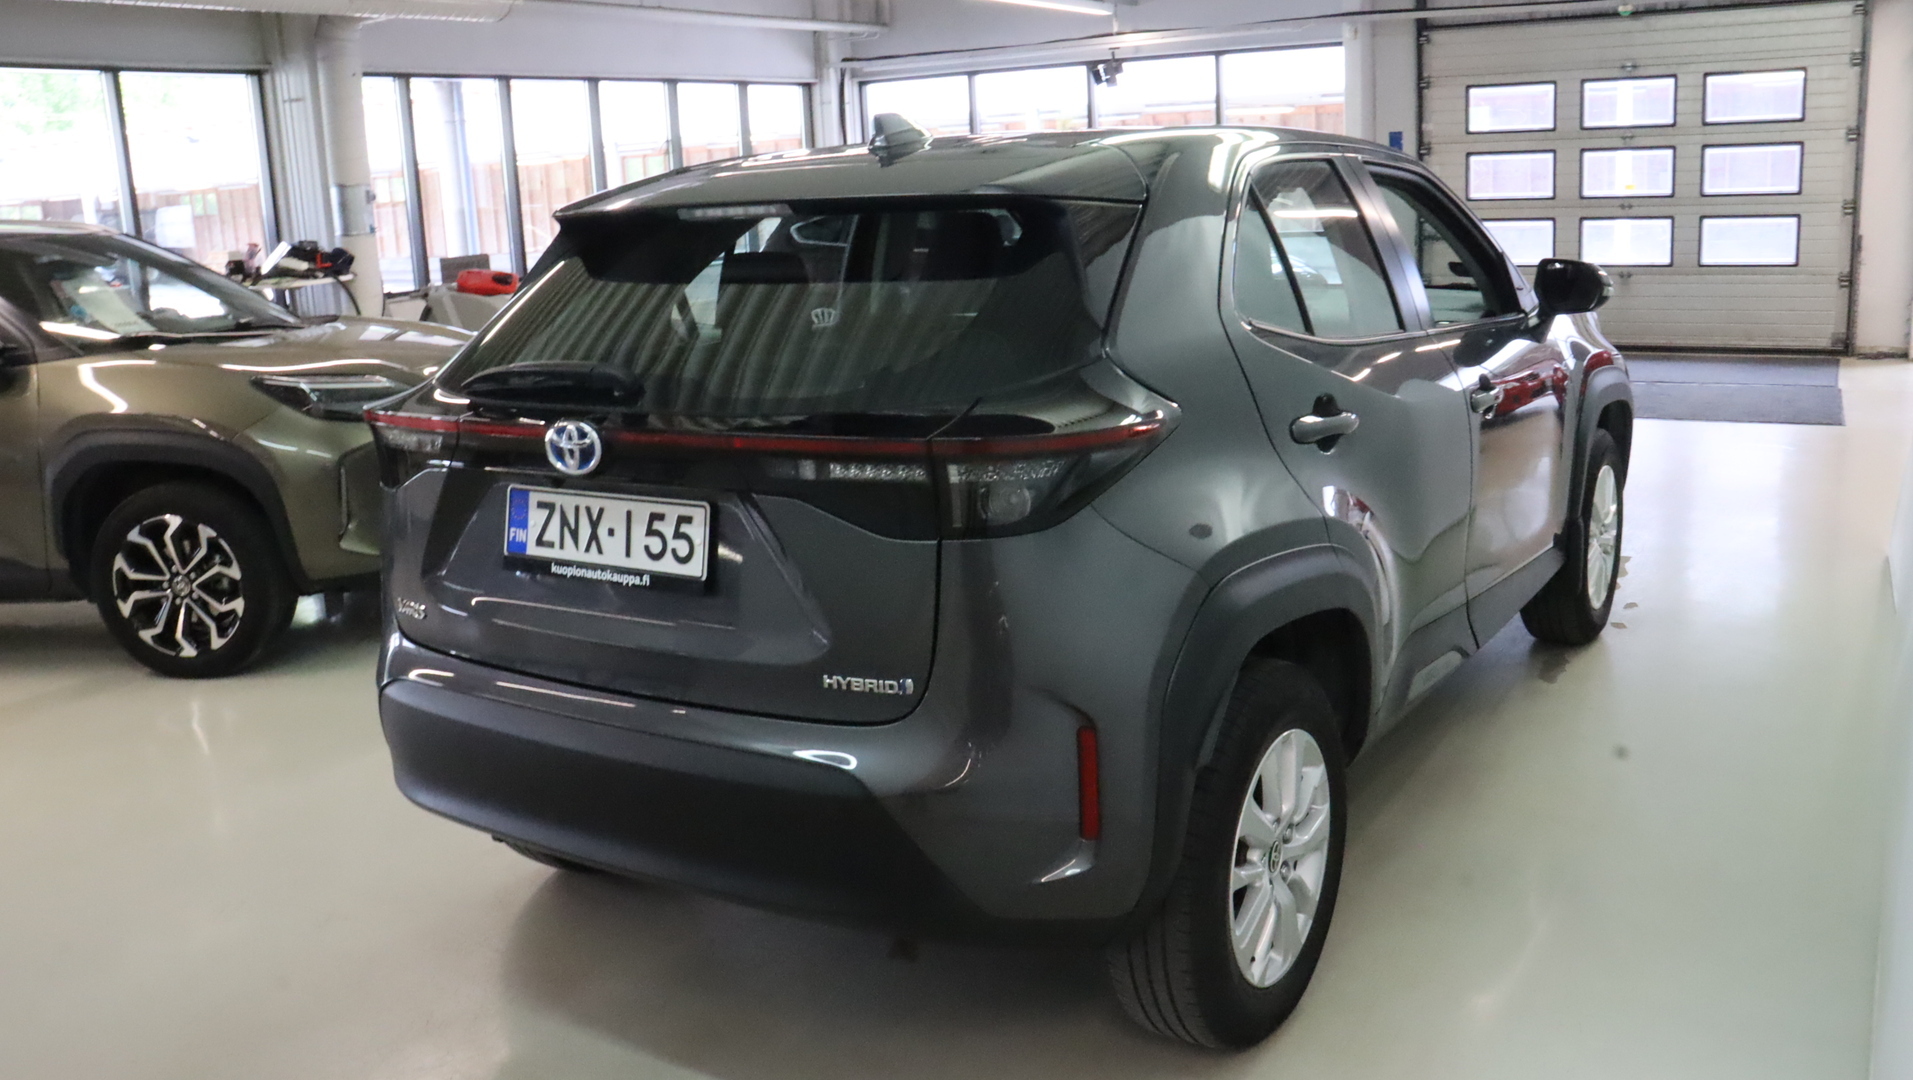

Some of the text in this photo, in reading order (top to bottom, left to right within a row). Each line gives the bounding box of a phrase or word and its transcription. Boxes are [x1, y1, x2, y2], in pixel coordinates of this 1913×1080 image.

[509, 527, 528, 543] FIN
[551, 562, 650, 587] kuopionautokauppa.fi
[823, 674, 899, 695] HYBRID
